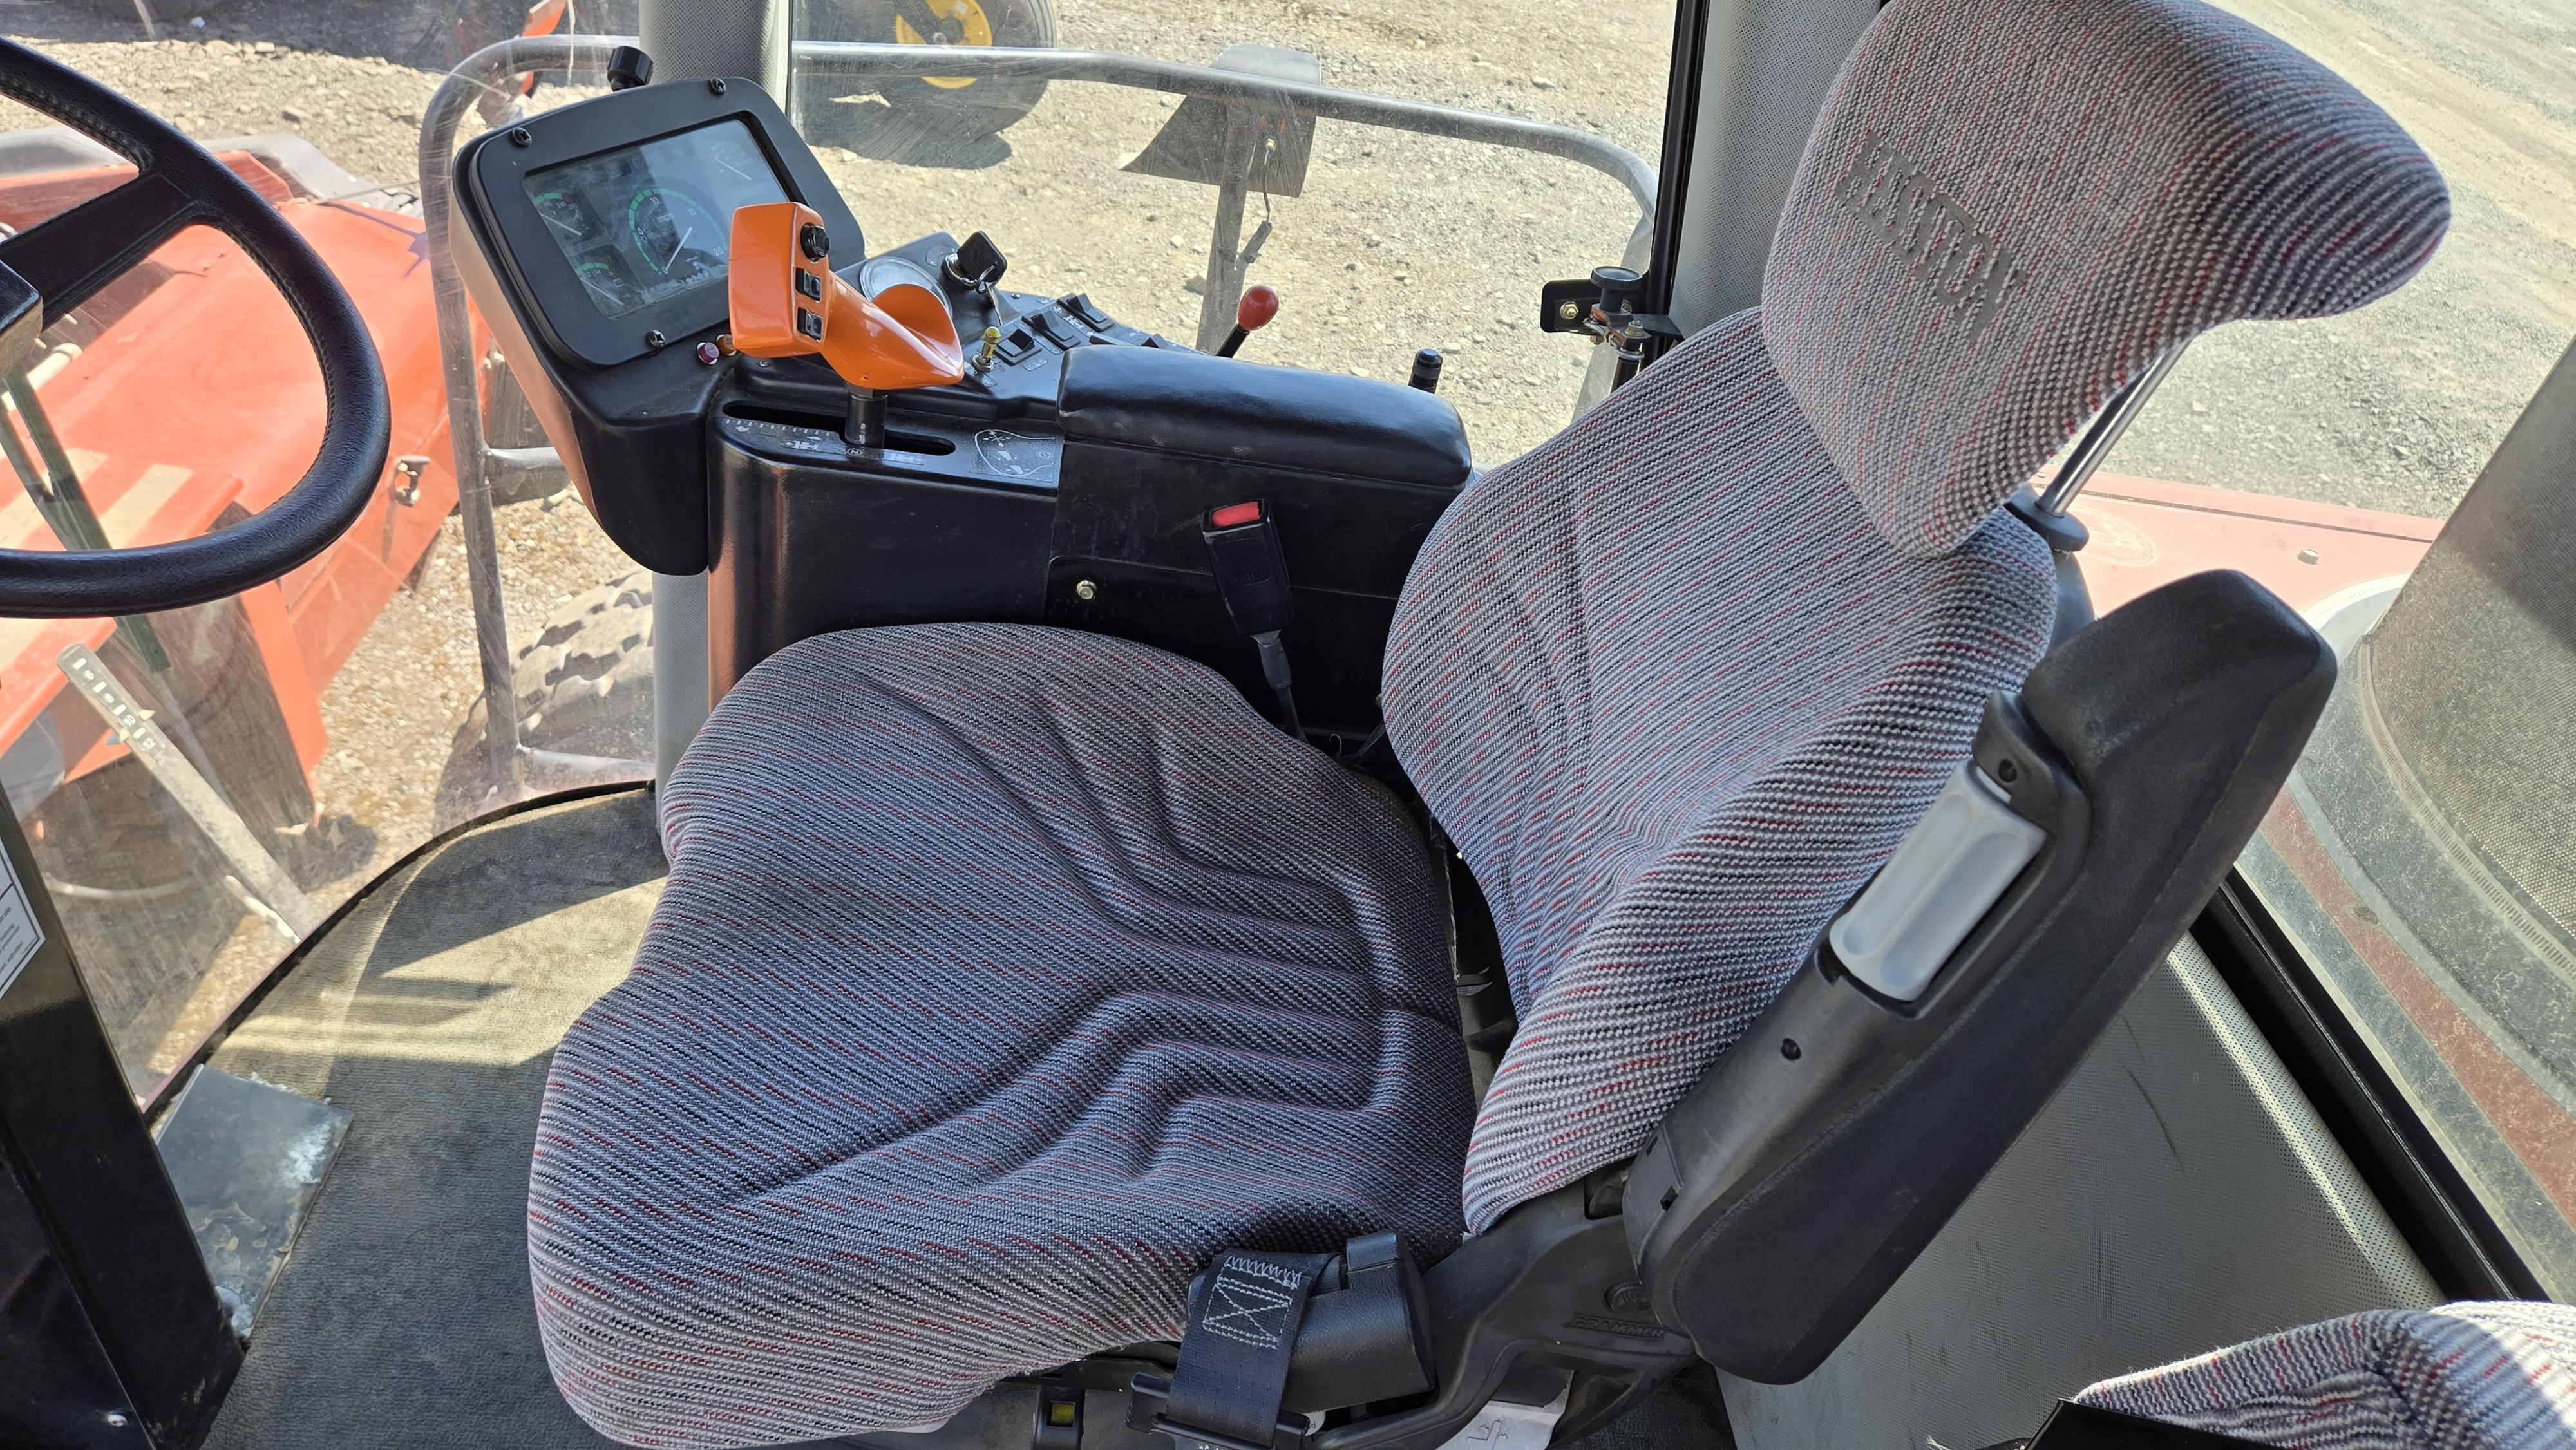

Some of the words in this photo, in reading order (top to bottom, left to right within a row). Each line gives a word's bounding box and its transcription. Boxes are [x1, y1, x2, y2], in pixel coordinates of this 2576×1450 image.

[650, 196, 659, 205] 10
[687, 207, 697, 216] 15
[637, 227, 644, 235] 5
[713, 246, 724, 256] 20
[661, 266, 668, 274] 0
[122, 715, 136, 727] 10
[143, 737, 156, 749] 12
[1572, 1316, 1664, 1338] GRAMMER
